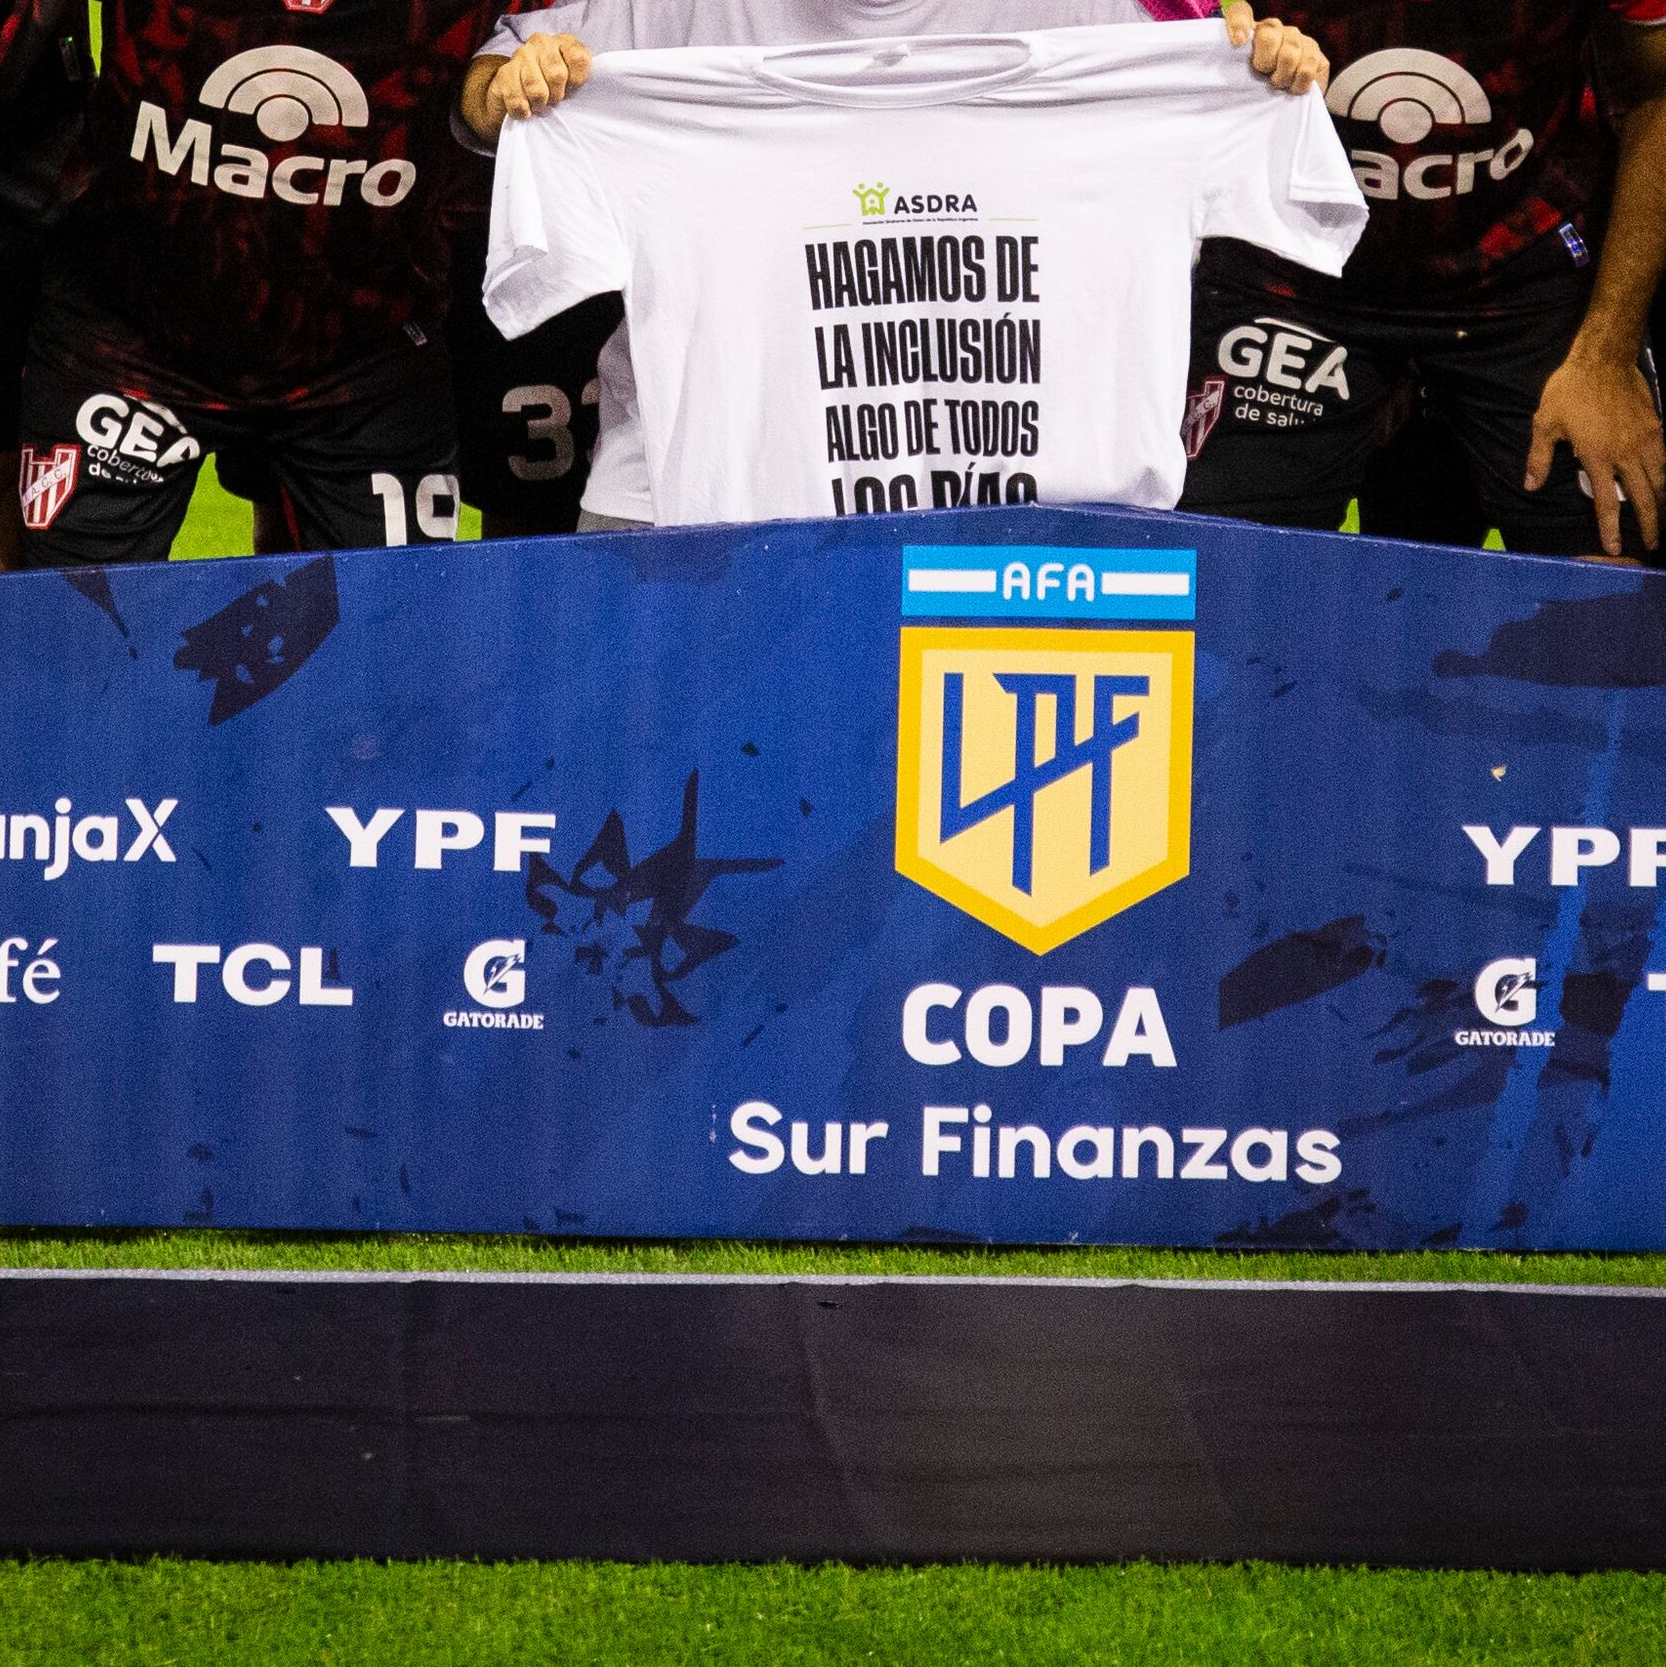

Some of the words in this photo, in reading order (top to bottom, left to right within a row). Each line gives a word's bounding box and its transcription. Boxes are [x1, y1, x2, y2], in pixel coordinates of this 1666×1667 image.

[130, 100, 417, 207] Macro
[1345, 128, 1534, 201] acro
[893, 193, 978, 216] ASDRA
[804, 235, 987, 311] HAGAMOS
[995, 235, 1041, 303] DE
[814, 323, 858, 391] LA
[860, 312, 1042, 388] INCLUSIÓN
[1218, 325, 1351, 401] GEA
[76, 393, 201, 468] GEA
[825, 402, 900, 463] ALGO
[904, 398, 941, 457] DE
[944, 398, 1040, 458] TODOS
[1233, 384, 1324, 417] cobertura
[1234, 402, 1261, 422] de
[371, 472, 461, 548] 19
[1002, 561, 1096, 603] AFA
[325, 806, 557, 872] YPF
[152, 943, 354, 1008] TCL
[463, 939, 526, 1009] G
[1474, 958, 1537, 1027] G
[443, 1011, 545, 1030] GATORADE
[901, 982, 1178, 1069] COPA
[1455, 1030, 1556, 1048] GATORADE
[728, 1101, 889, 1175] Sur
[921, 1105, 1344, 1184] Finanzas
